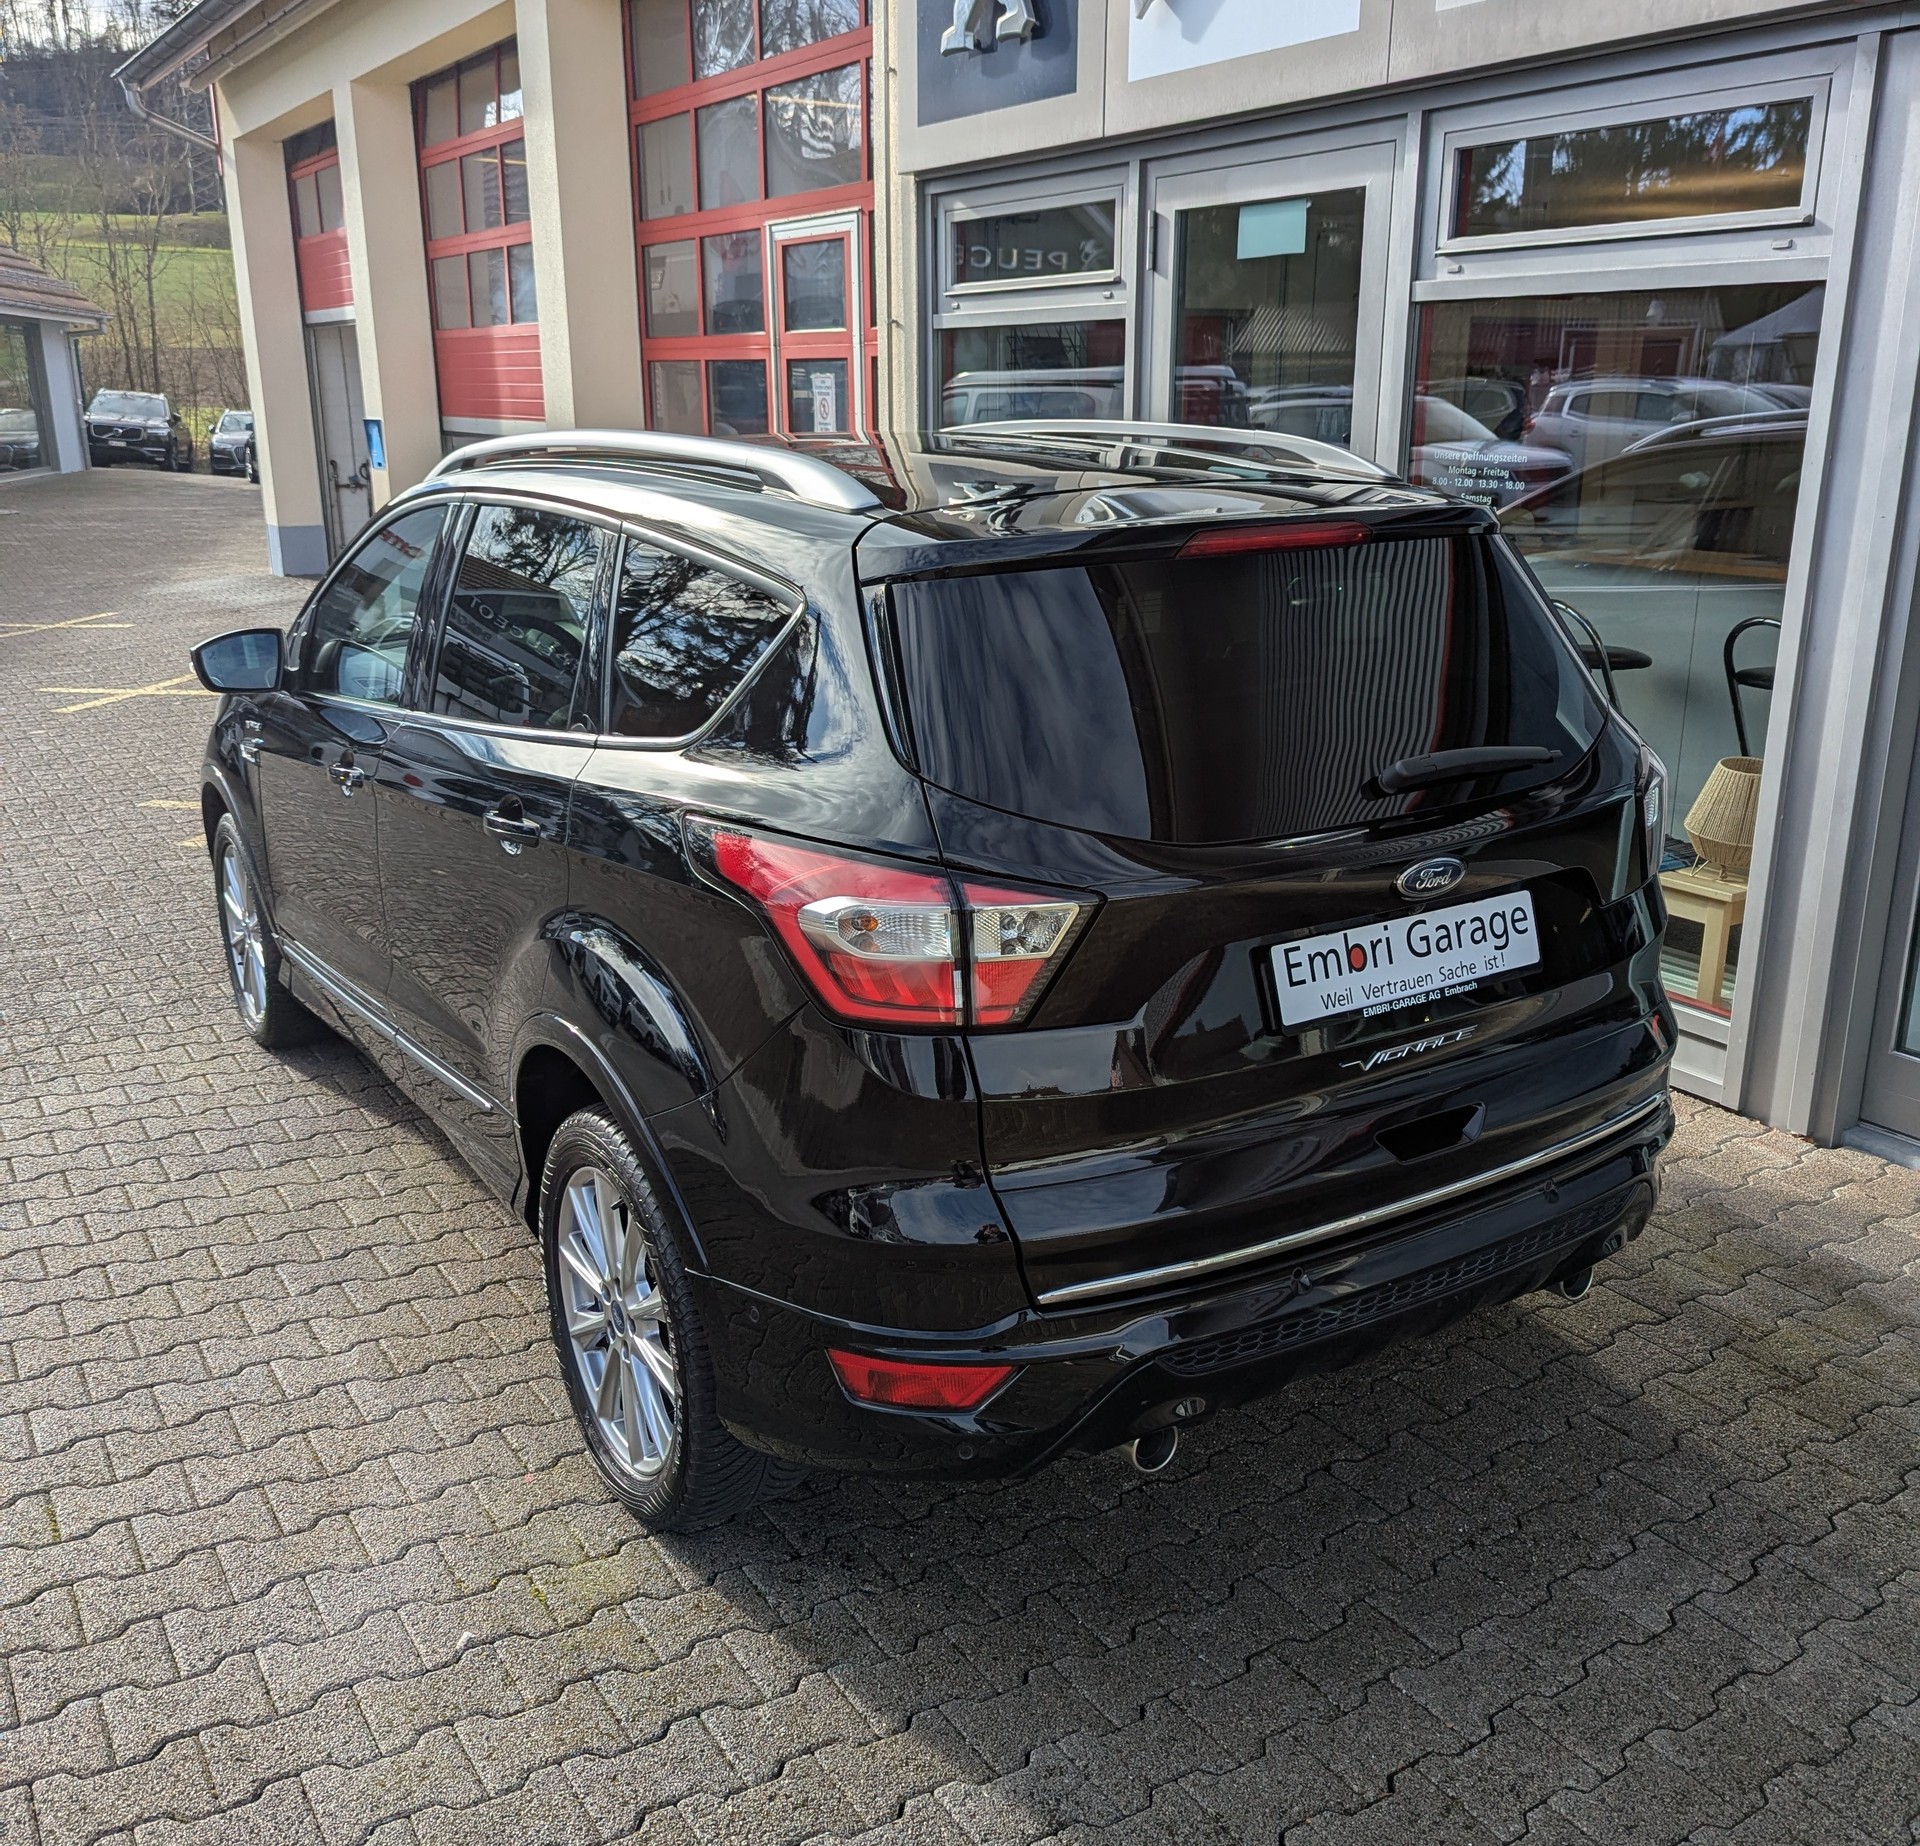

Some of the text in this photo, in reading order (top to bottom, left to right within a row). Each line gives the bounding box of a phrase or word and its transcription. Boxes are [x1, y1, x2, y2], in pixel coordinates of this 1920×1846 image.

[1434, 451, 1528, 464] Unsere Oeffnungszeiten
[1432, 477, 1448, 486] 8.00
[1454, 478, 1473, 487] 12.00
[1478, 480, 1498, 489] 13.30
[1505, 481, 1525, 490] 18.00
[1448, 465, 1477, 477] Montag
[1483, 468, 1510, 479] Freitag
[1461, 493, 1491, 505] Samstag
[1416, 866, 1453, 890] Ford
[1283, 905, 1530, 988] Embri Garage
[1320, 986, 1354, 1011] Weil
[1361, 972, 1435, 1002] Vertrauen
[1438, 960, 1478, 983] Sache
[1362, 980, 1479, 1019] EMBRI-GARAGE AG Embrach
[1340, 1024, 1478, 1072] VIGNALE
